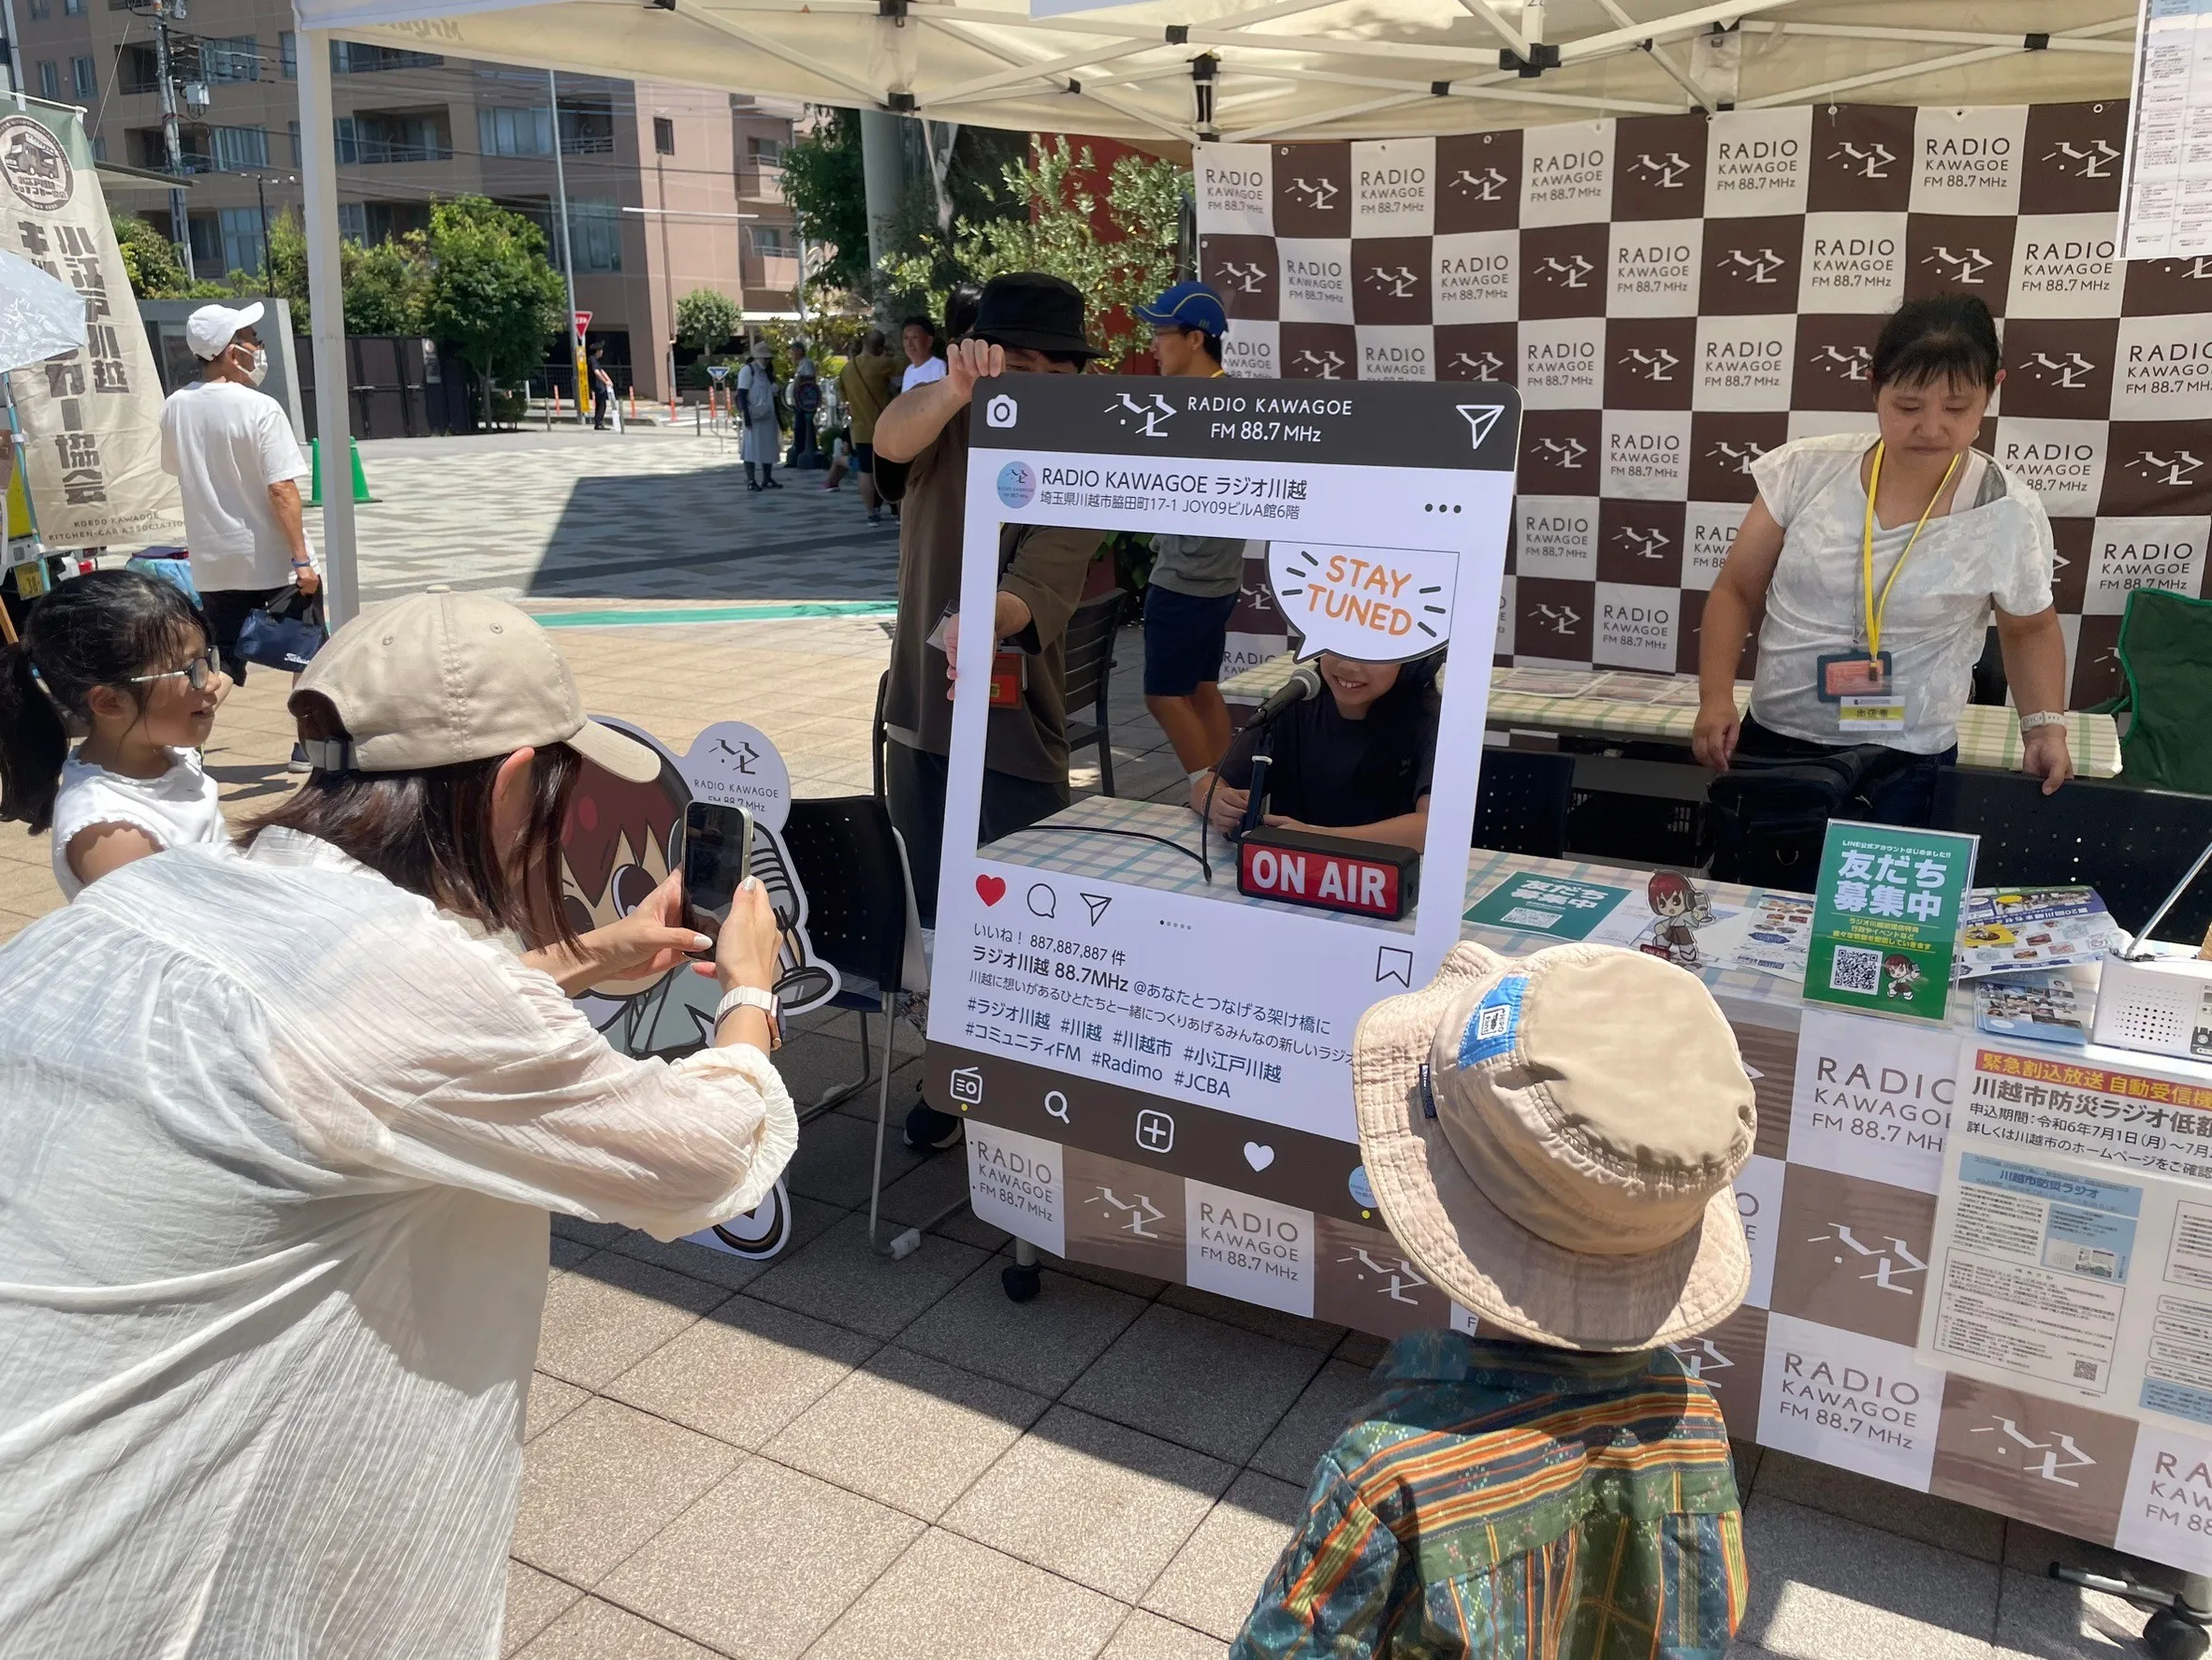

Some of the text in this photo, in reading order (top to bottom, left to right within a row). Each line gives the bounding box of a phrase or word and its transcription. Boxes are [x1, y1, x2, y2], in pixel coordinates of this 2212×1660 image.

[1719, 139, 1797, 159] RADIO
[1926, 138, 2010, 155] RADIO
[1533, 150, 1604, 173] RADIO
[1717, 160, 1797, 174] KAWAGOE
[1925, 159, 2009, 171] KAWAGOE
[1205, 168, 1263, 186] RADIO
[1361, 167, 1425, 186] RADIO
[1531, 170, 1603, 187] KAWAGOE
[1716, 177, 1796, 191] FM 88.7 MHz
[1924, 174, 2007, 187] FM 88.7 MHz
[1206, 187, 1263, 200] KAWAGOE
[1361, 187, 1425, 199] KAWAGOE
[1530, 186, 1602, 203] FM 88.7 MHz
[1618, 245, 1690, 263] RADIO
[1814, 239, 1895, 256] RADIO
[2026, 240, 2115, 260] RADIO
[1287, 259, 1342, 277] RADIO
[1441, 255, 1508, 274] RADIO
[1618, 266, 1689, 278] KAWAGOE
[1812, 259, 1893, 271] KAWAGOE
[2023, 263, 2113, 276] KAWAGOE
[1288, 276, 1344, 290] KAWAGOE
[1441, 273, 1508, 287] KAWAGOE
[1617, 280, 1687, 293] FM 88.7 MHz
[1812, 274, 1892, 287] FM 88.7 MHz
[2021, 279, 2110, 291] FM 88.7 MHz
[1442, 288, 1507, 301] FM 88.7 MHz
[1225, 342, 1271, 357] ADIO
[1365, 347, 1425, 362] RADIO
[1527, 342, 1594, 359] RADIO
[1706, 340, 1783, 357] RADIO
[1366, 364, 1425, 375] KAWAGOE
[1527, 361, 1594, 372] KAWAGOE
[1705, 360, 1782, 371] KAWAGOE
[2127, 363, 2212, 378] KAWAGO
[1527, 374, 1593, 386] FM 88.7 MHz
[1704, 374, 1780, 386] FM 88.7 MHz
[2126, 380, 2212, 394] FM 88.7 MH
[1187, 397, 1352, 415] RADIO KAWAGOE
[1211, 421, 1322, 443] FM 88.7 MHz
[1610, 433, 1680, 450] RADIO
[1610, 452, 1680, 464] KAWAGOE
[2007, 444, 2093, 461] RADIO
[1610, 466, 1678, 478] FM 88.7 MHz
[1041, 468, 1308, 501] RADIO KAWAGOE ラジオ川越
[2059, 481, 2088, 491] MHz
[73, 517, 108, 528] KOEDO
[122, 519, 186, 535] ASSOCIATIO
[1525, 517, 1589, 532] RADIO
[1525, 533, 1588, 546] KAWAGOE
[1695, 525, 1739, 542] RAD
[2103, 543, 2193, 560] RADIO
[1693, 557, 1709, 567] FM
[2102, 562, 2190, 575] KAWAGOE
[1326, 555, 1412, 598] STAY
[2100, 578, 2188, 590] FM 887 MHz
[1308, 583, 1412, 635] TUNED
[1603, 604, 1669, 624] RADIO
[1603, 621, 1668, 636] KAWAGOE
[1602, 633, 1667, 650] FM 88.7 MHz
[693, 779, 779, 798] RADIO KAWAGOE
[745, 800, 765, 812] MHz
[1838, 850, 1947, 889] 友だち
[1252, 851, 1387, 908] ON AIR
[1834, 880, 1943, 922] 募集中
[1029, 935, 1108, 962] 887,887,887
[1111, 949, 1127, 967] 件
[972, 945, 1331, 1035] ラジオ川越 88.7MHz @あなたとつなげる架け橋に
[967, 997, 1282, 1084] #ラジオ川越 #川越 #川越市 #小江戸川越
[966, 1021, 1231, 1098] #コミュニティFM #Radimo #JCBA
[1982, 1053, 2104, 1090] 緊急割込放送
[1812, 1113, 1945, 1153] FM 88.7 MH
[977, 1140, 1052, 1185] RADIO
[978, 1164, 1053, 1203] KAWAGOE
[2000, 1170, 2099, 1199] 川越市防災ラジオ
[980, 1183, 1054, 1222] FM 88.7 MHz
[1201, 1201, 1299, 1244] RADIO
[1201, 1226, 1300, 1262] KAWAGOE
[1201, 1245, 1299, 1282] FM 88.7 MHz
[1784, 1352, 1920, 1405] RADIO
[1782, 1379, 1917, 1428] KAWAGOE
[1780, 1401, 1913, 1449] FM 88.7 MHz
[2146, 1503, 2212, 1536] FM 88
